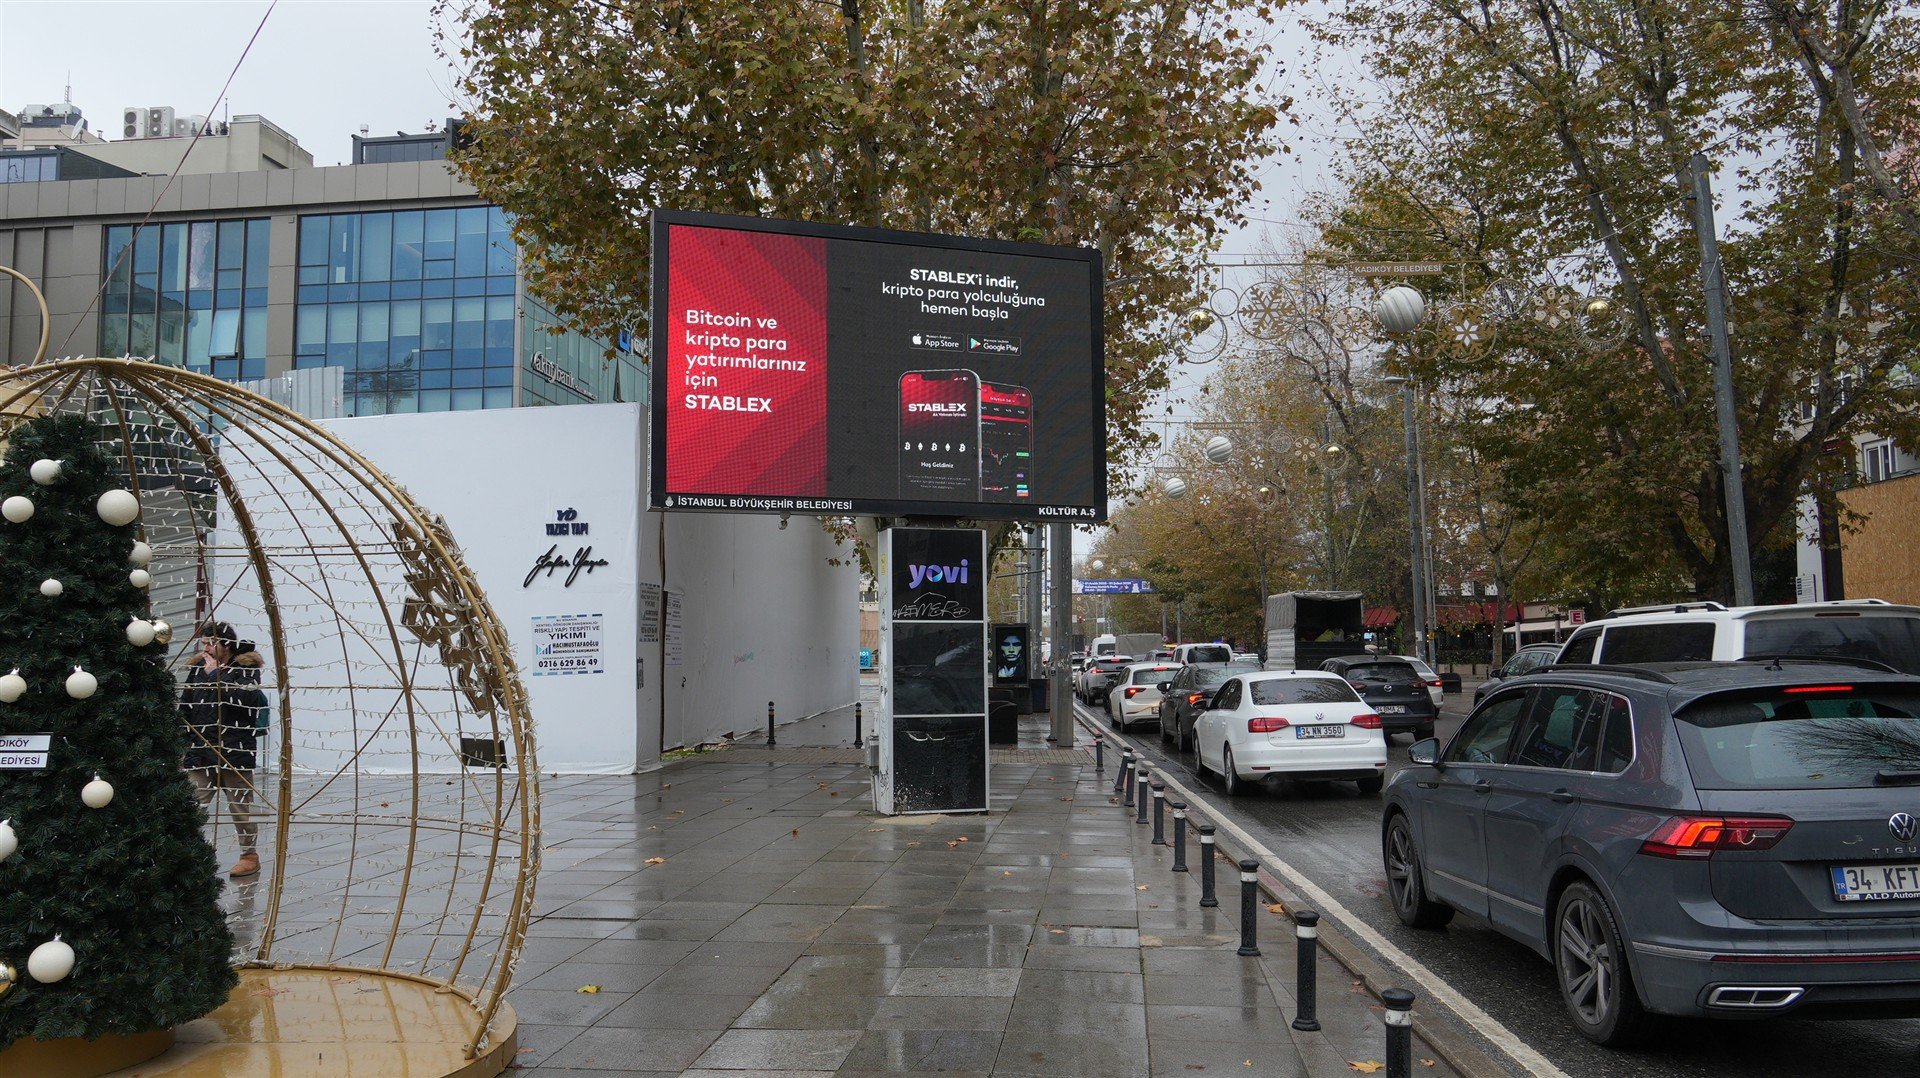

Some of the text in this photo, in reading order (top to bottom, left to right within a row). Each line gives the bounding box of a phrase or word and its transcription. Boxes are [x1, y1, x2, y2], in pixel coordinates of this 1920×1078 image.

[1394, 263, 1441, 272] BELEDİYESİ
[985, 274, 1019, 290] indir,
[882, 282, 1045, 307] kripto para yolculuğuna
[921, 301, 1009, 321] hemen başla
[686, 309, 777, 329] Bitcoin ve
[686, 329, 787, 353] kripto para
[925, 339, 959, 348] App Store
[983, 342, 1019, 352] Google Play
[685, 352, 806, 372] yatırımlarınız
[685, 370, 718, 390] için
[685, 394, 772, 413] STABLEX
[908, 403, 967, 412] STABLEX
[932, 461, 954, 469] Geldiniz
[678, 495, 852, 510] İSTANBUL BÜYÜKŞEHİR BELEDİYESİ
[1038, 506, 1096, 518] KÜLTÜR A.Ş
[571, 522, 589, 535] YAPI
[908, 558, 968, 590] yovi
[1573, 612, 1581, 622] E
[549, 631, 586, 640] YIKIMI
[552, 640, 599, 648] HACIMUSTAFAOĞLU
[538, 660, 558, 668] 0216
[560, 659, 574, 667] 629
[588, 658, 598, 666] 49
[1301, 726, 1342, 735] 34 NN 3560
[1, 755, 40, 765] EDİYESİ
[1846, 869, 1872, 891] 34
[1883, 867, 1919, 889] KFT
